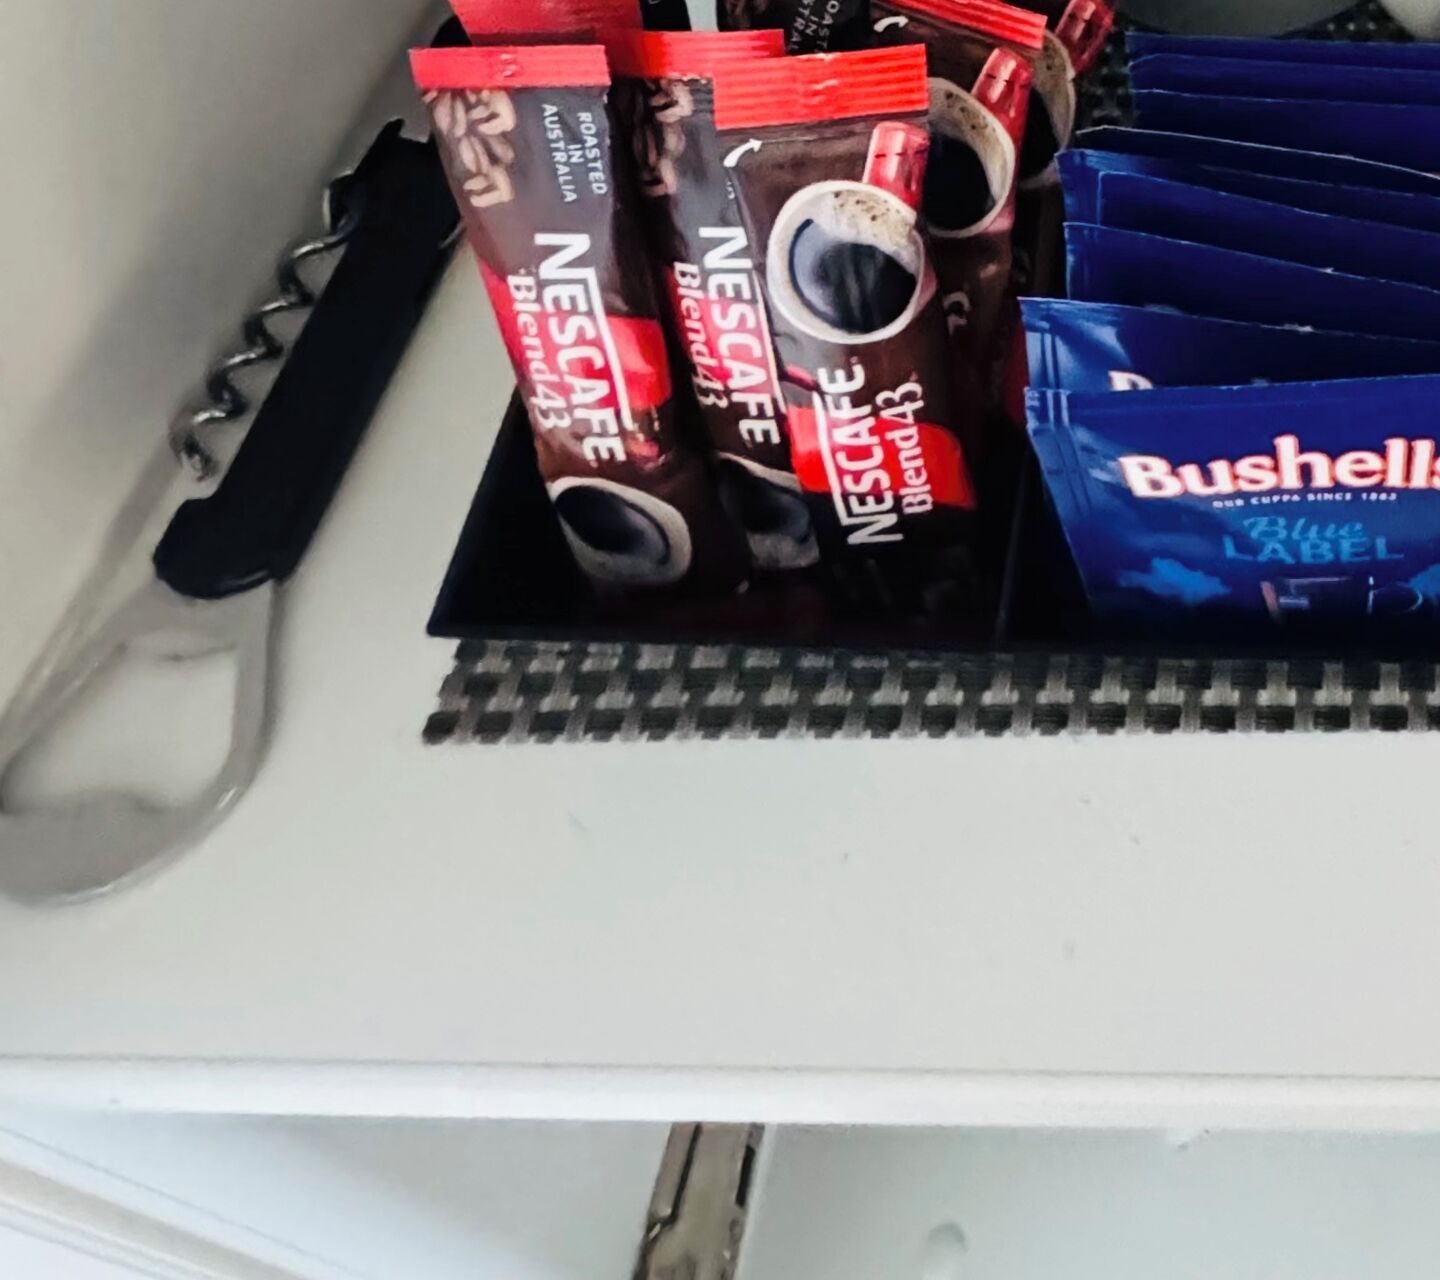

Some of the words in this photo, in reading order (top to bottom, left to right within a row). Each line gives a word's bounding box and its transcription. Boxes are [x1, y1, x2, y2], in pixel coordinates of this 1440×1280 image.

[542, 103, 577, 203] AUSTRALIA
[567, 144, 583, 163] IN
[577, 112, 607, 194] ROASTED
[1242, 515, 1364, 541] Blue
[1222, 535, 1405, 565] LABEL
